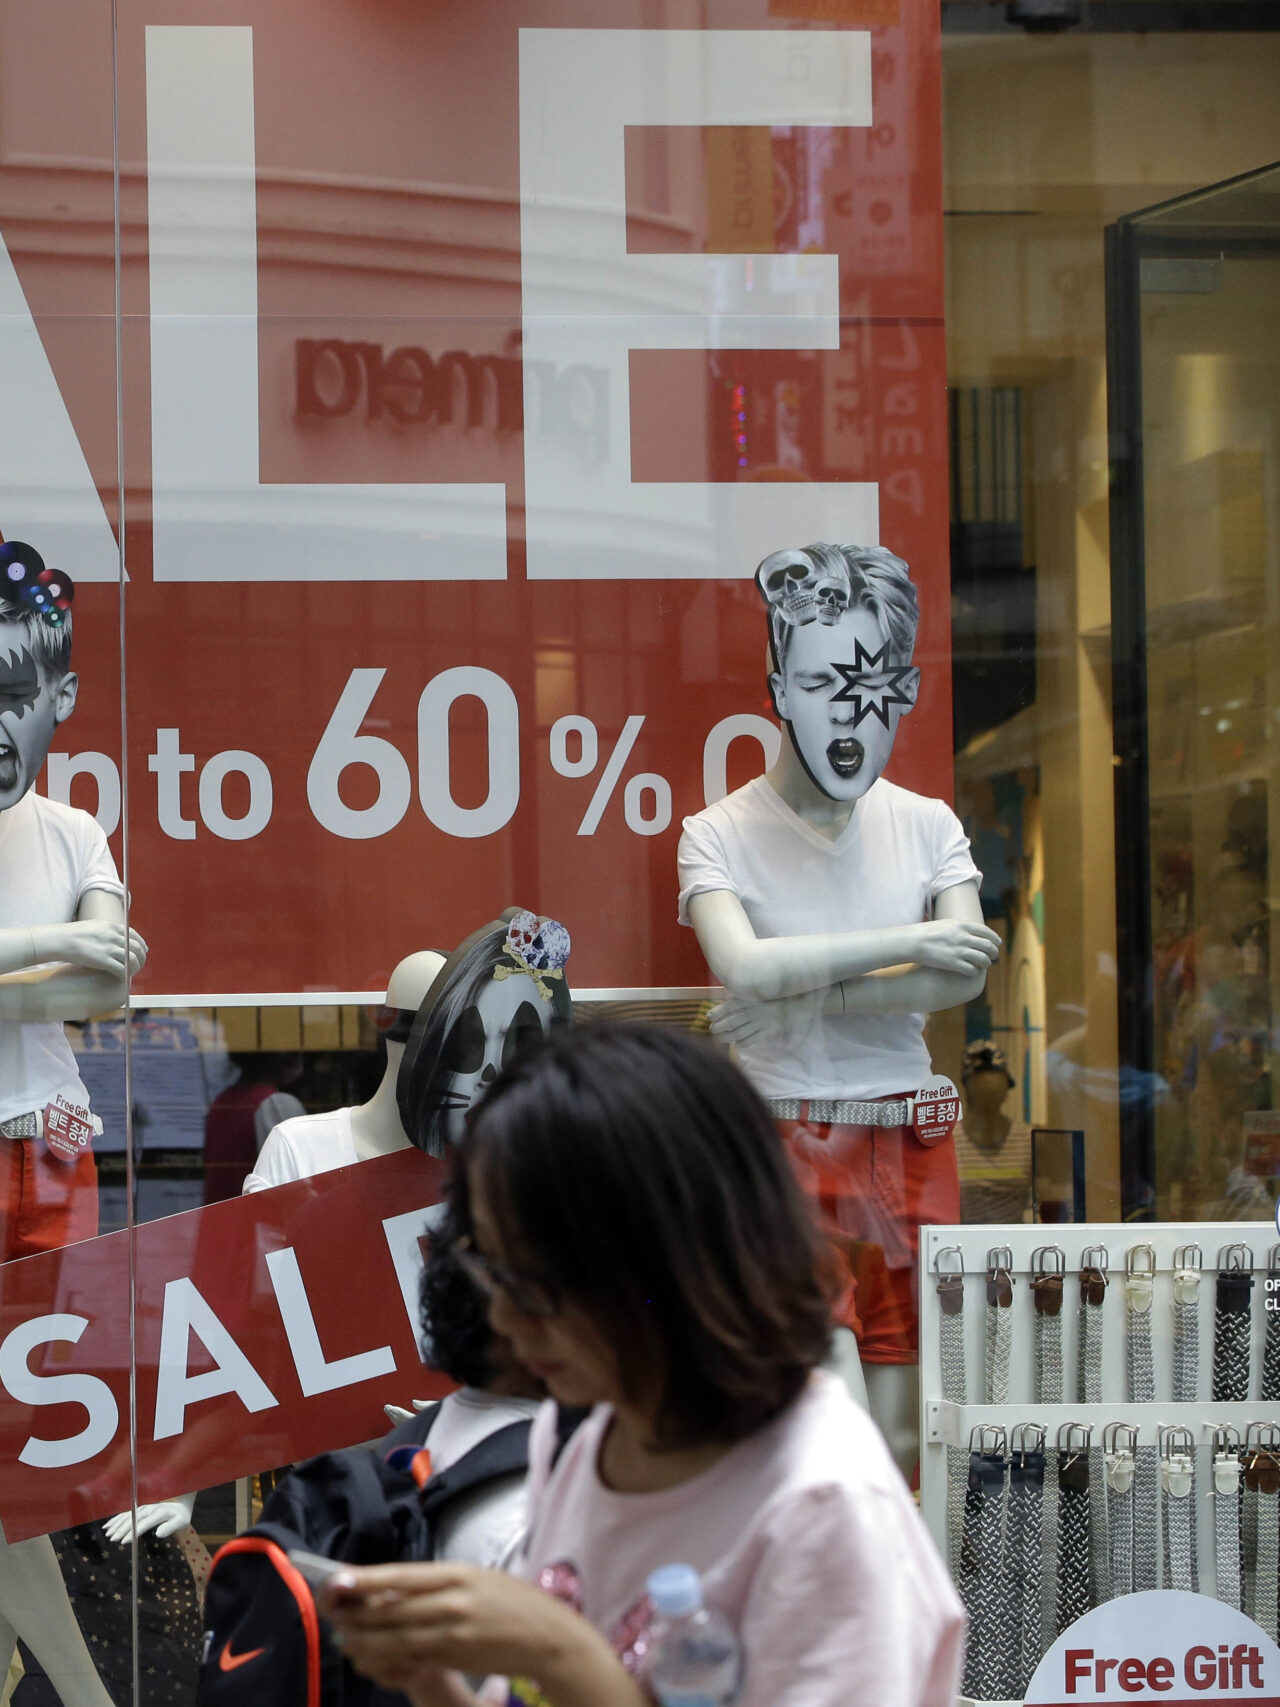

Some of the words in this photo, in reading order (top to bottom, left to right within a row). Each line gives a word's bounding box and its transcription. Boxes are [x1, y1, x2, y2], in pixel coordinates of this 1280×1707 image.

[148, 727, 273, 840] to
[55, 1093, 75, 1113] Free
[75, 1104, 89, 1121] Gift
[920, 1089, 938, 1100] Free
[939, 1085, 953, 1097] Gift
[47, 1108, 69, 1135] 벨트
[68, 1120, 89, 1146] 증정
[916, 1104, 936, 1126] 벨트
[937, 1101, 956, 1123] 증정
[1064, 1648, 1175, 1694] Free
[1183, 1644, 1265, 1690] Gift
